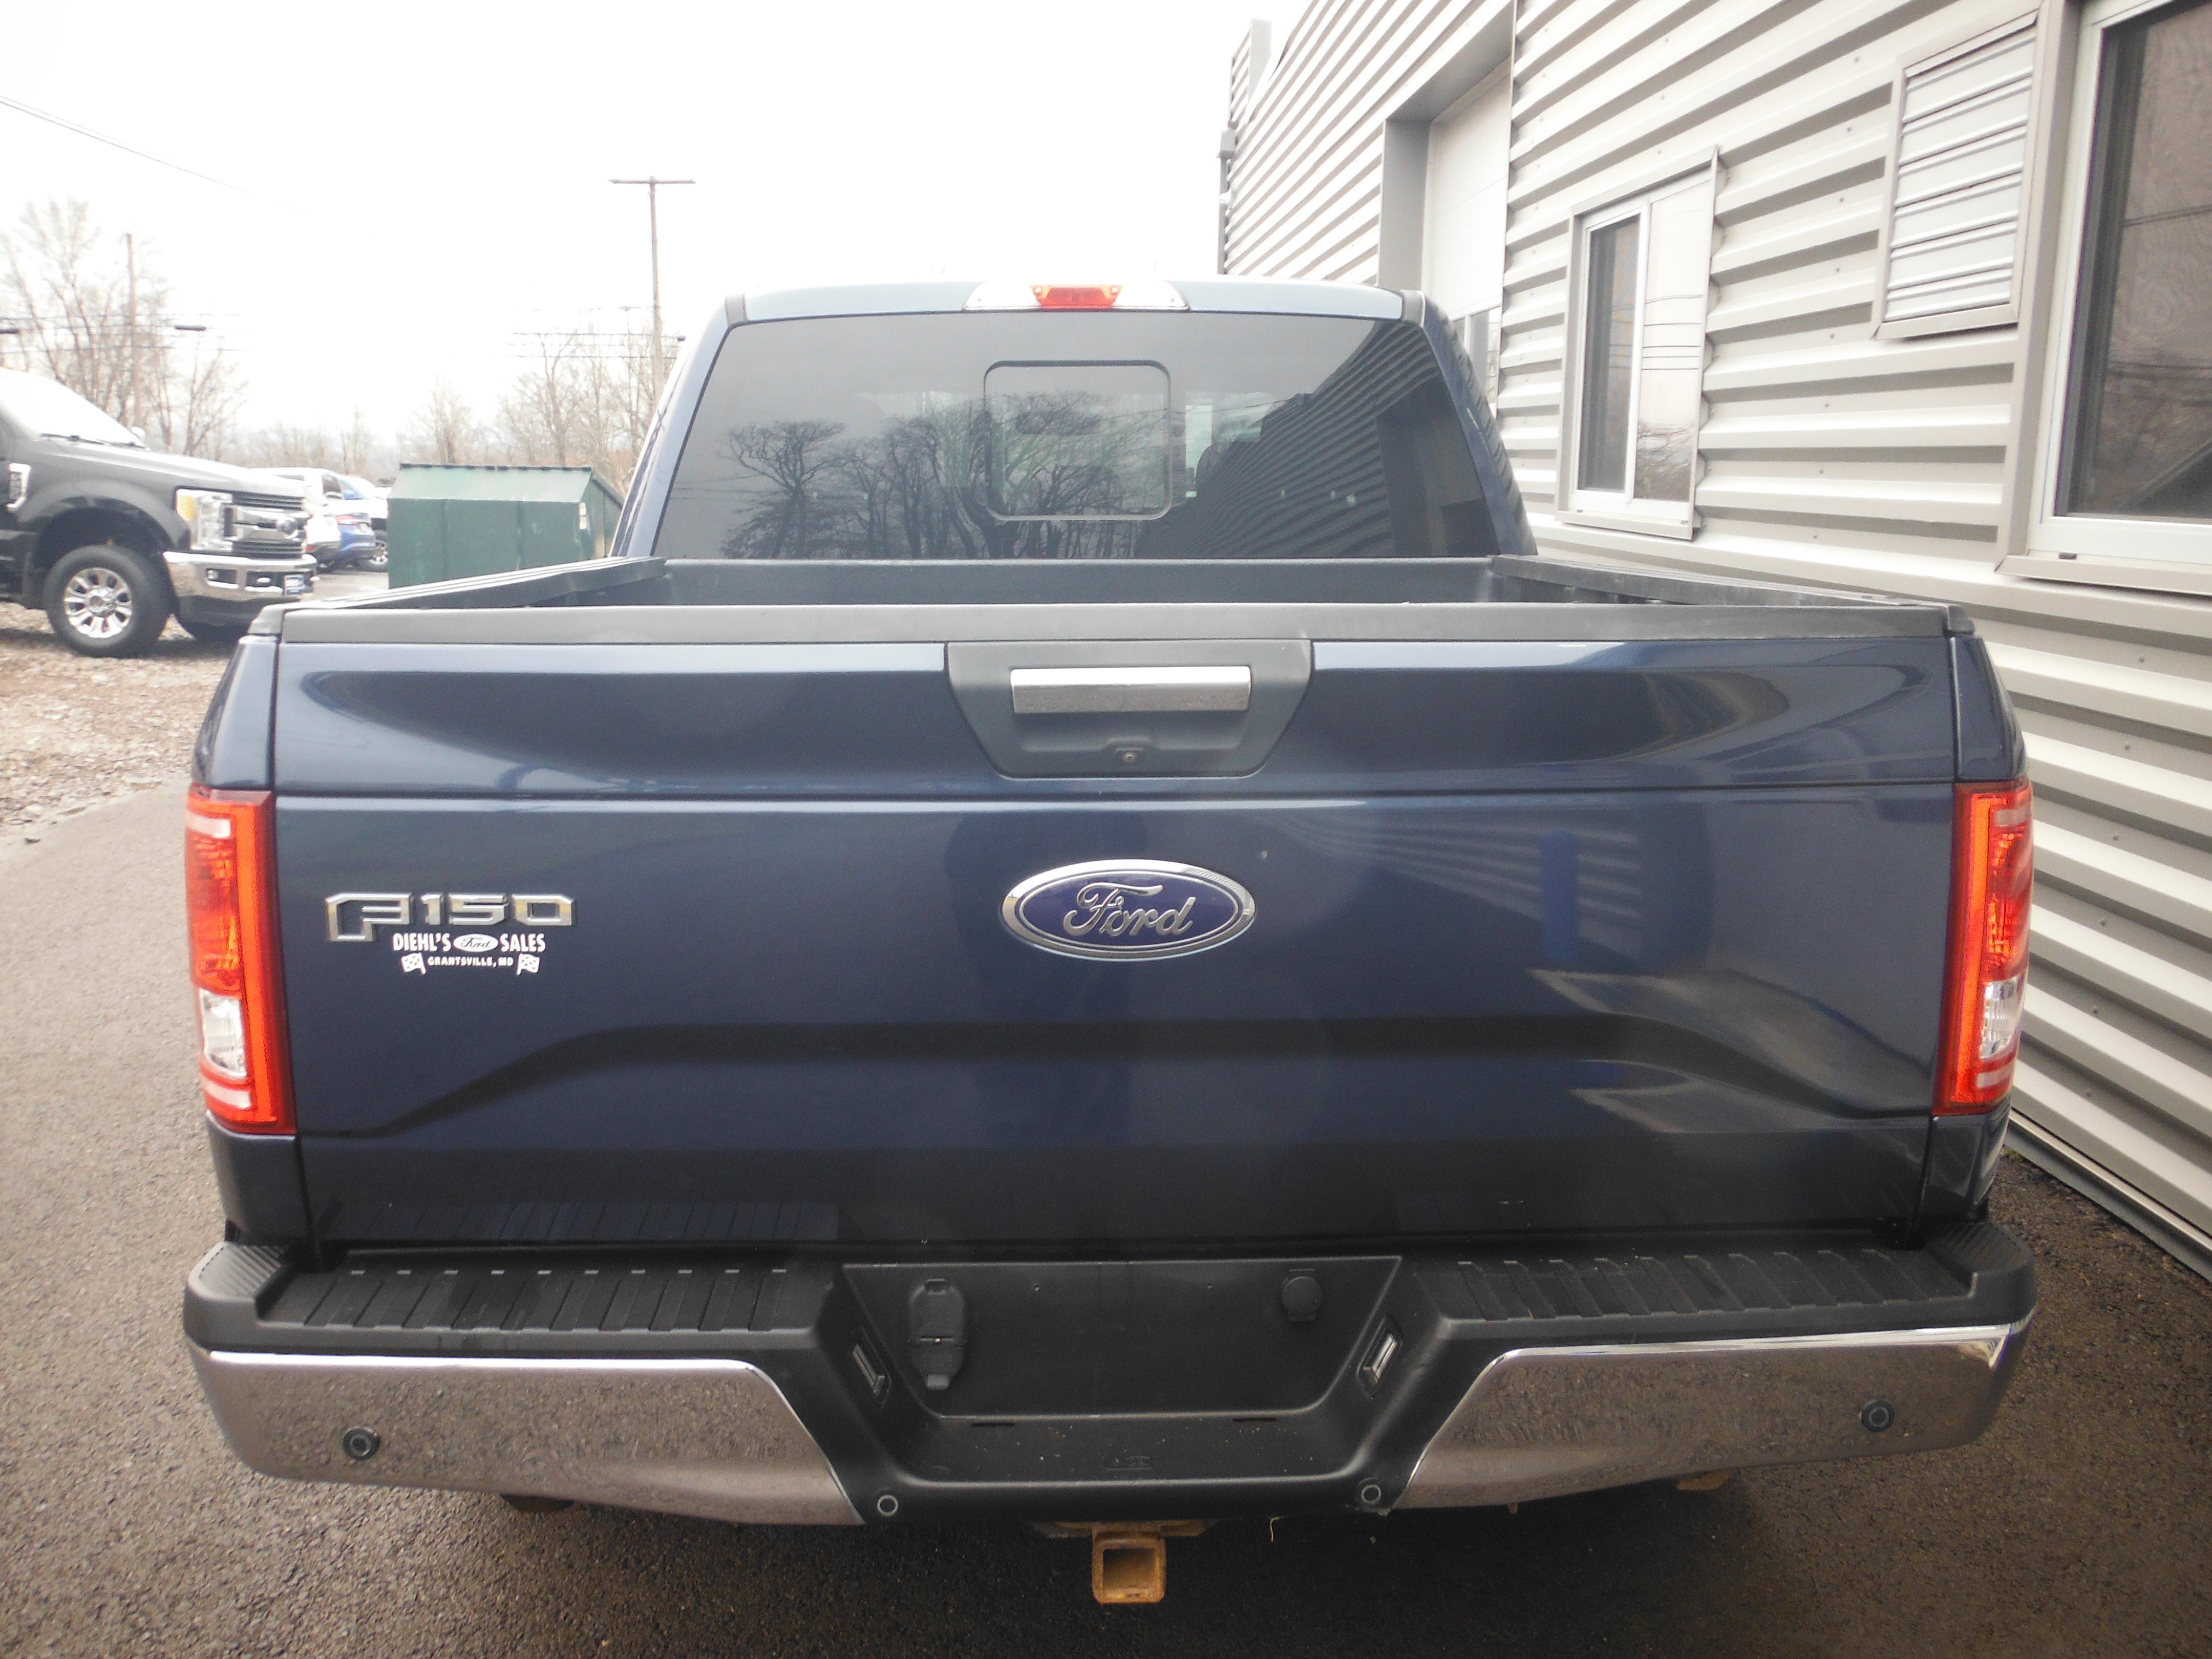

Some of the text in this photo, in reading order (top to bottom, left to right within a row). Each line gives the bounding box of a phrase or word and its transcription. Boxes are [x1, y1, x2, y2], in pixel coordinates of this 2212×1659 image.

[1064, 882, 1196, 936] Ford
[393, 932, 546, 952] DIEHL'S Ford SALES
[427, 956, 514, 968] GRANTSVILLE, MD
